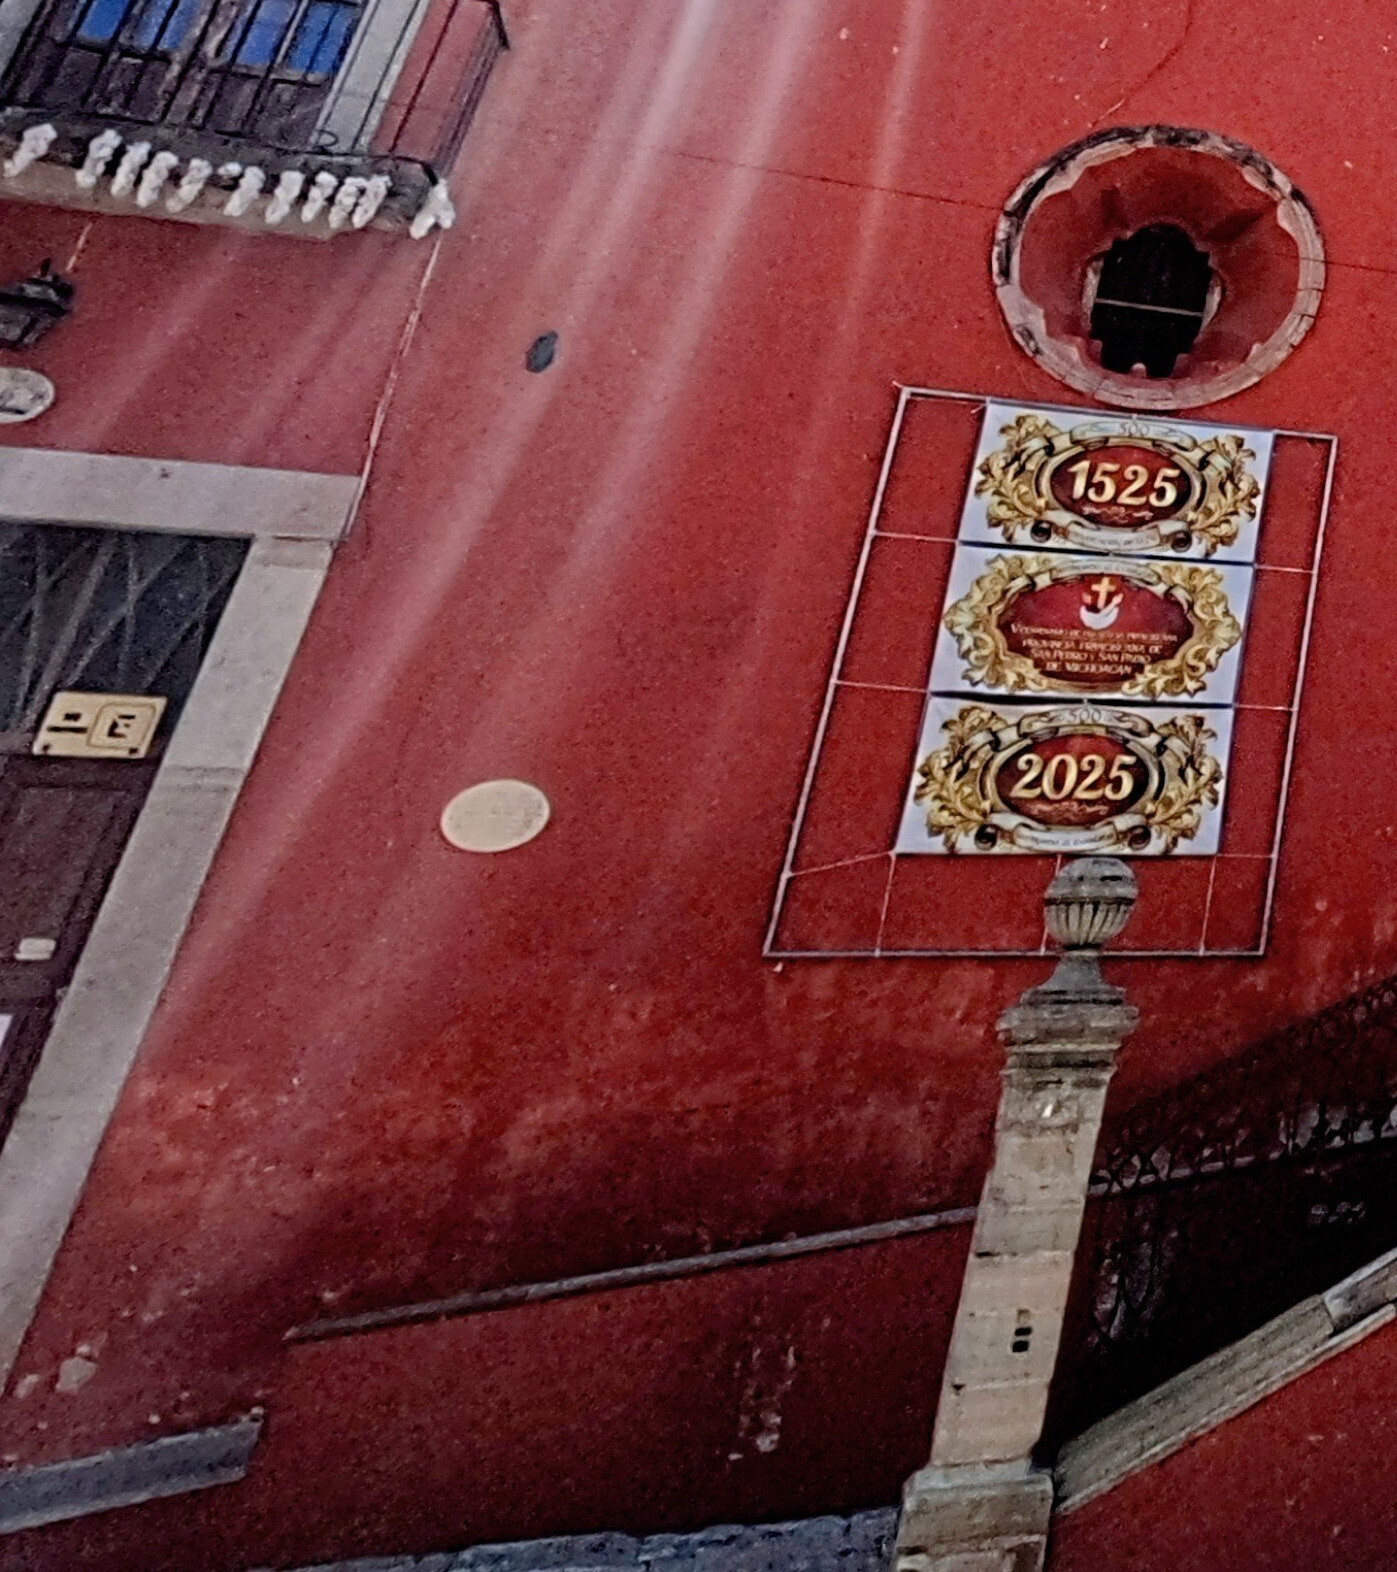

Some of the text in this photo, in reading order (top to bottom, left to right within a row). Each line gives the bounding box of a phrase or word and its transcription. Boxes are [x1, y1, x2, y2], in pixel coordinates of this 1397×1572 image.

[1120, 423, 1149, 437] 500
[1066, 460, 1181, 508] 1525
[1053, 650, 1088, 661] PEDRO
[1066, 708, 1101, 723] 500
[1009, 753, 1138, 801] 2025
